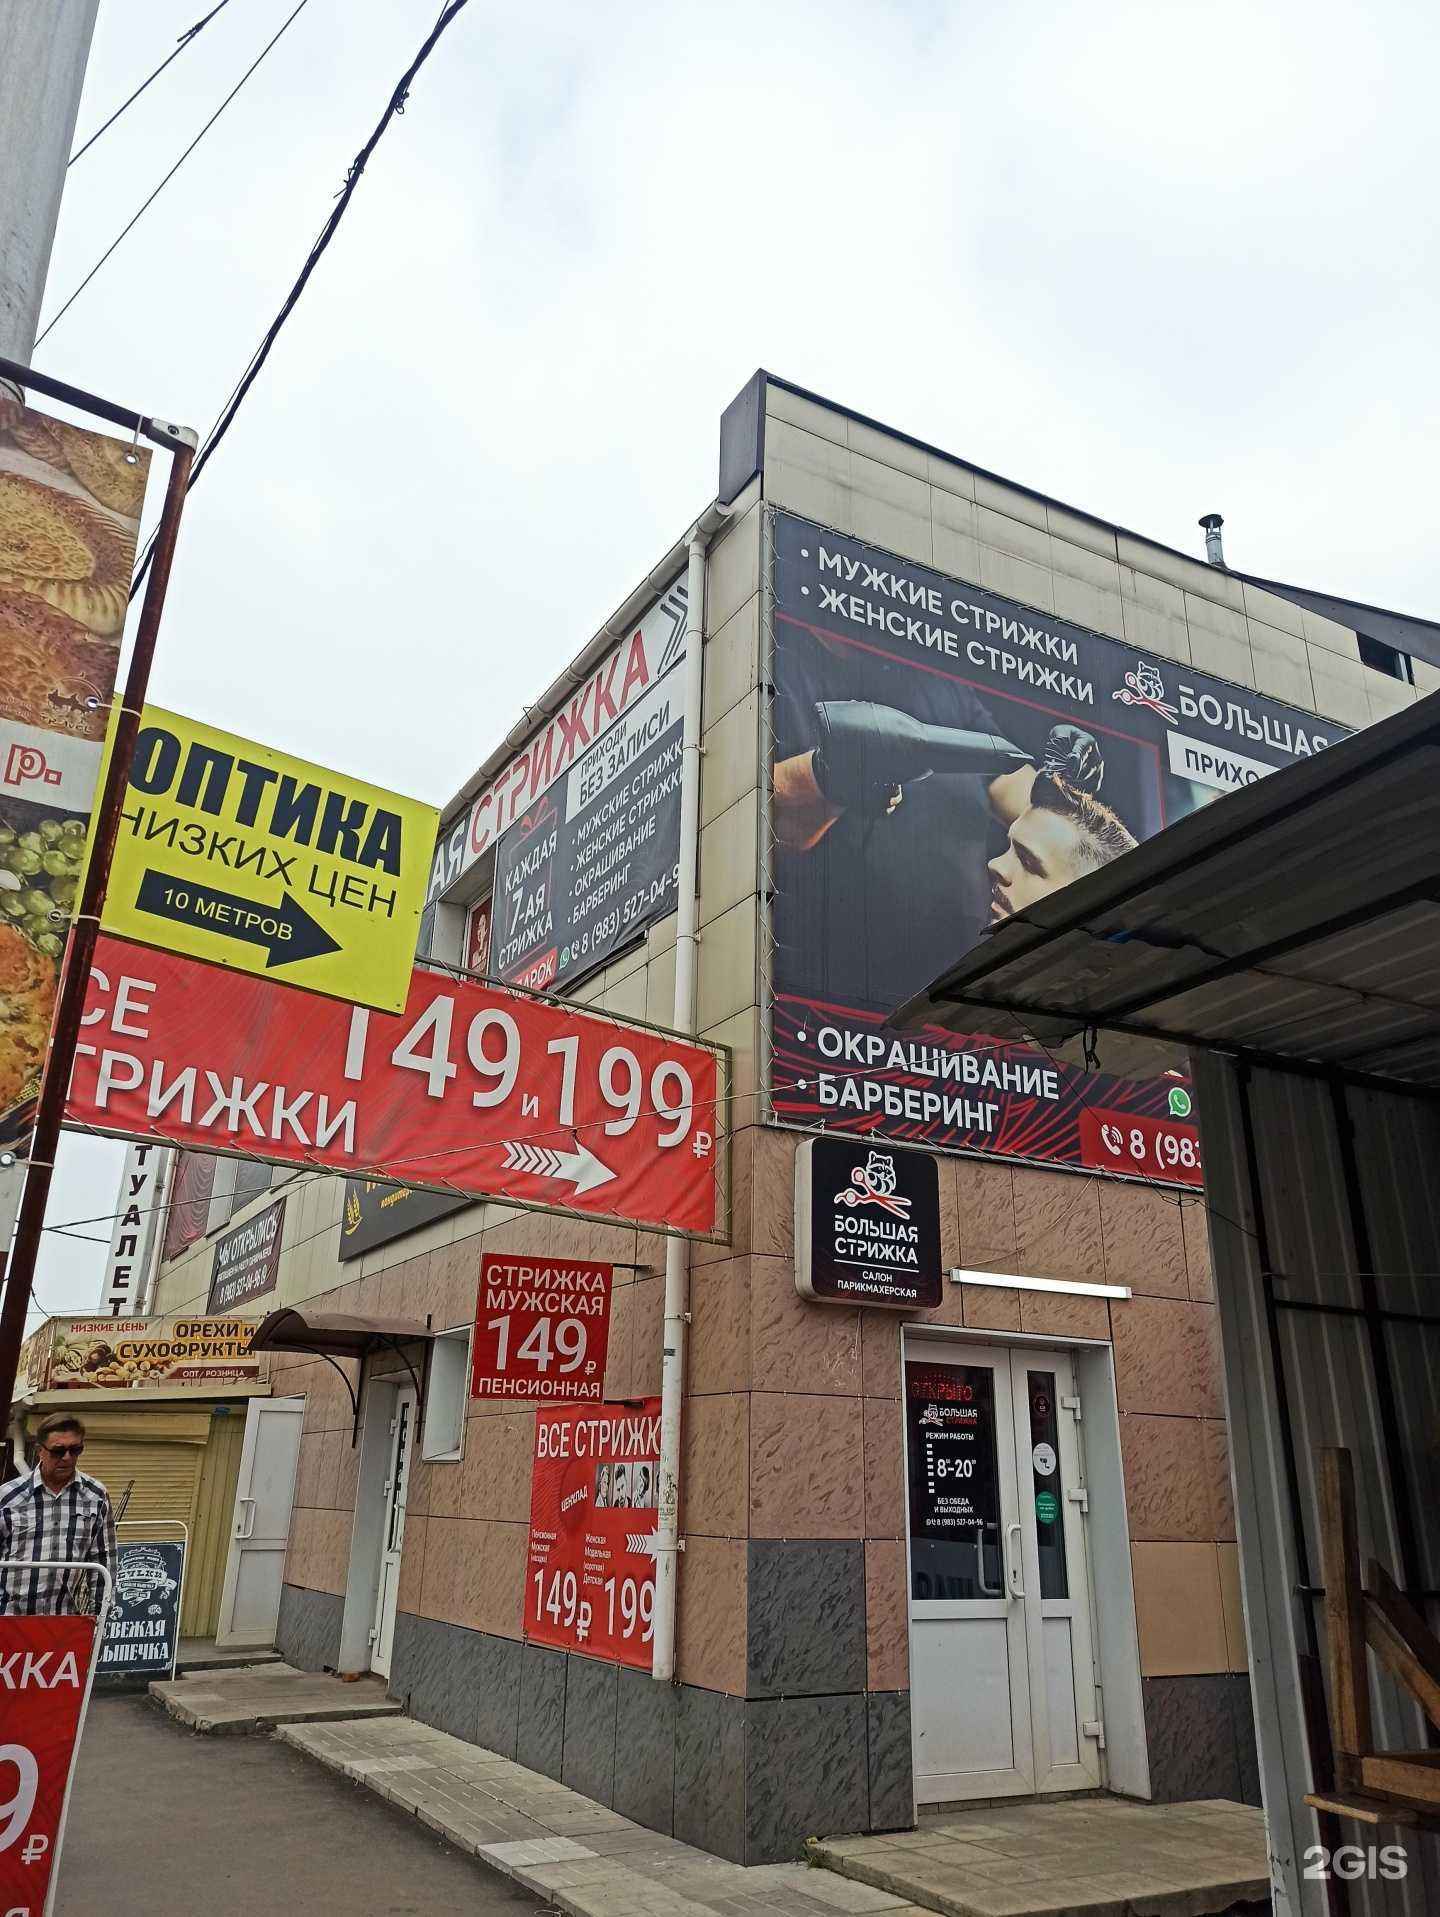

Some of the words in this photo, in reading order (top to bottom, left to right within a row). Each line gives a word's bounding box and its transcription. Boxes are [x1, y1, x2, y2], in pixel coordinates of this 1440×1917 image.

[818, 546, 943, 616] МУЖКИЕ
[950, 599, 1080, 666] СТРИЖКИ
[818, 583, 959, 658] ЖЕНСКИЕ
[966, 640, 1095, 705] СТРИЖКИ
[470, 629, 649, 855] СТРИЖКА
[579, 765, 604, 807] БЕЗ
[607, 699, 670, 782] ЗАПИСИ
[580, 720, 627, 779] ПРИХОДИ
[1184, 747, 1260, 787] ПРИХО
[127, 727, 402, 878] ОПТИКА
[577, 784, 630, 846] МУЖСКИЕ
[632, 736, 683, 797] СТРИЖК
[121, 804, 298, 887] НИЗКИХ
[308, 864, 398, 918] ЦЕН
[504, 829, 558, 894] КАЖДАЯ
[574, 815, 656, 897] ОКРАШИВАНИЕ
[575, 809, 627, 873] ЖЕНСКИЕ
[164, 887, 190, 910] 10
[195, 896, 293, 942] МЕТРОВ
[509, 880, 546, 938] 7-АЯ
[572, 863, 632, 926] БАРБЕРИНГ
[581, 932, 590, 955] 8
[591, 907, 620, 951] (983)
[622, 863, 681, 927] 527-04-9
[498, 918, 554, 971] СТРИЖКА
[342, 995, 523, 1111] 149
[817, 1026, 1060, 1101] ОКРАШИВАНИЕ
[818, 1072, 1000, 1134] БАРБЕРИНГ
[1128, 1127, 1147, 1160] 8
[1155, 1130, 1202, 1170] (98
[109, 1144, 153, 1317] ТУАЛЕТ
[833, 1214, 919, 1245] БОЛЬШАЯ
[834, 1237, 919, 1265] СТРИЖКА
[486, 1264, 606, 1293] СТРИЖКА
[486, 1288, 604, 1316] МУЖСКАЯ
[837, 1280, 918, 1299] ПАРИКМАХЕРСКАЯ
[862, 1270, 893, 1283] САЛОН
[70, 1322, 114, 1333] НИЗКИЕ
[117, 1321, 148, 1333] ЦЕНЫ
[119, 1341, 253, 1359] СУХОФРУКТЫ
[175, 1323, 240, 1338] ОРЕХИ
[205, 1368, 245, 1378] РОЗНИЦА
[478, 1377, 601, 1398] ПЕНСИОННАЯ
[537, 1421, 571, 1459] ВСЕ
[574, 1415, 662, 1458] СТРИЖК
[925, 1431, 949, 1440] РЕЖИМ
[949, 1432, 975, 1441] РАБОТЫ
[939, 1407, 978, 1418] БОЛЬШАЯ
[937, 1497, 949, 1505] БЕЗ
[949, 1497, 970, 1506] ОБЕДА
[939, 1506, 974, 1514] ВЫХОДНЫХ
[98, 1642, 169, 1662] ЫПЕЧКА
